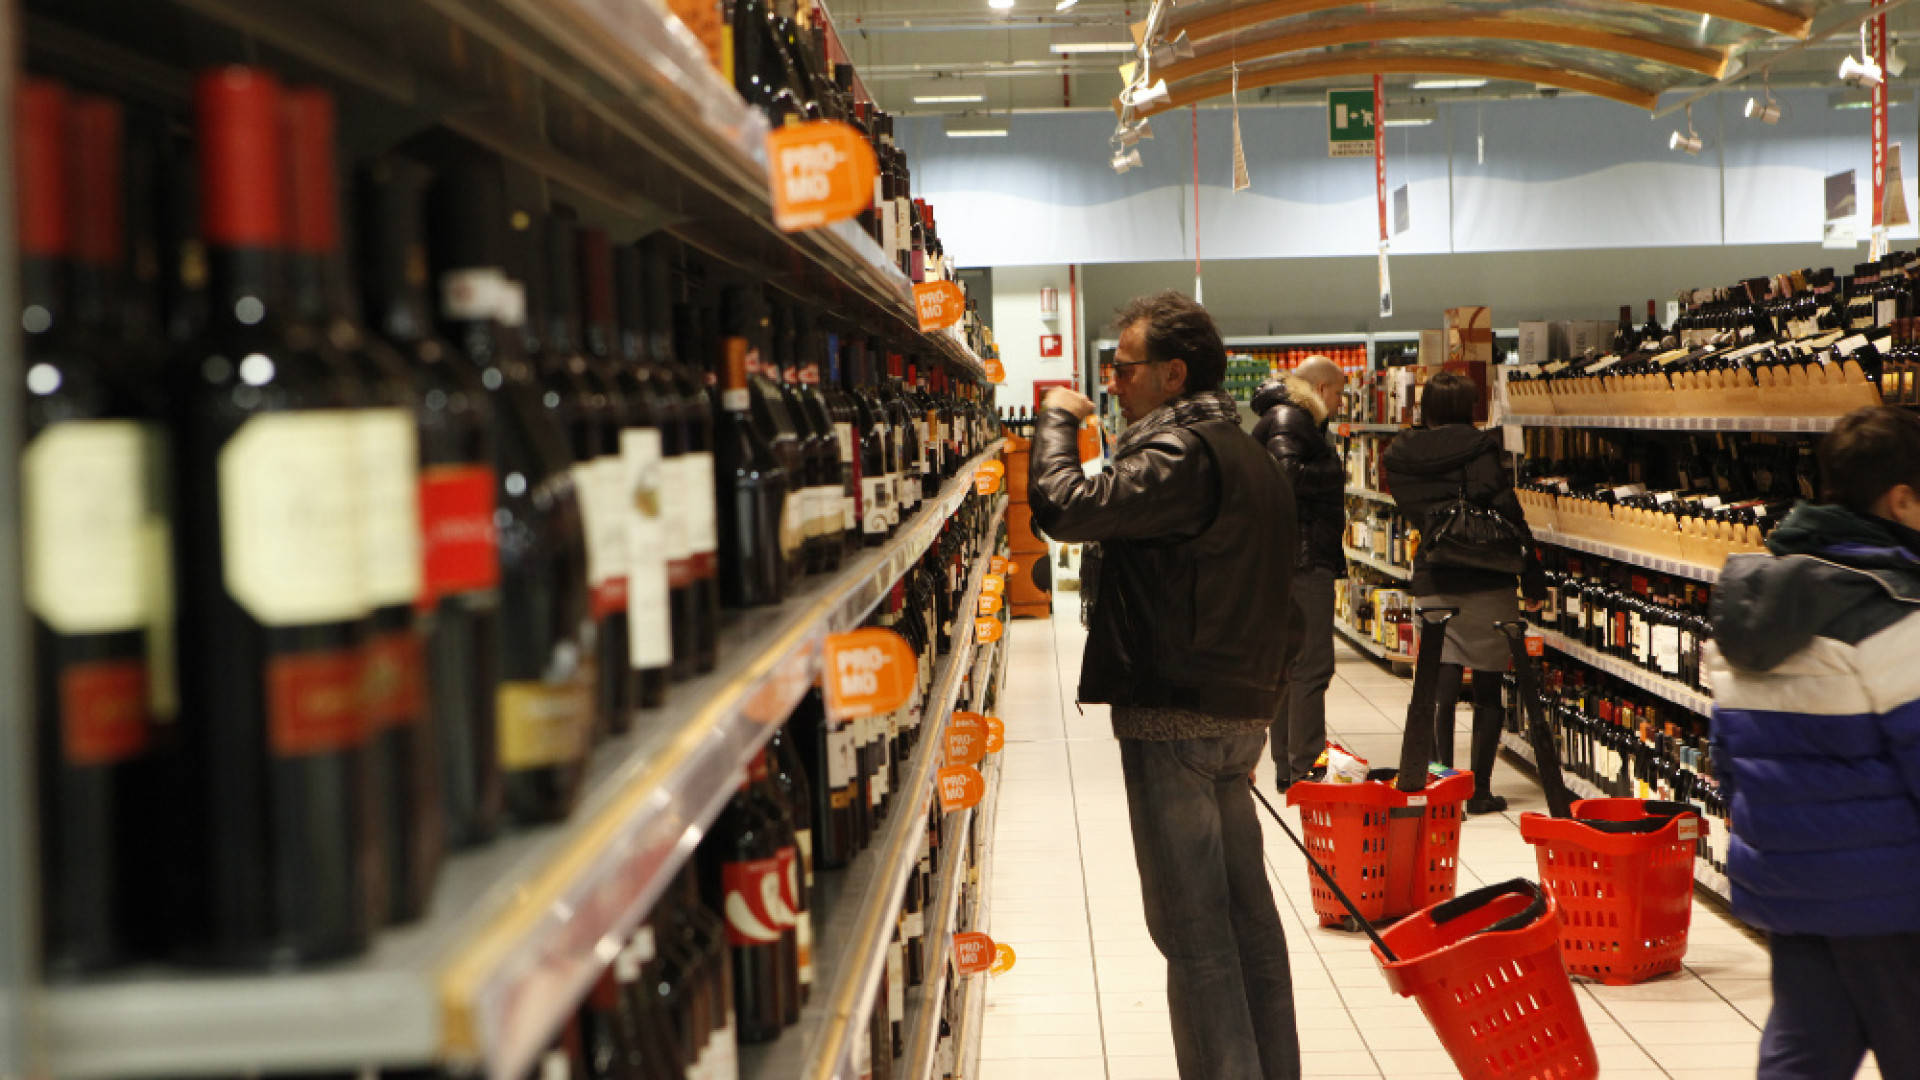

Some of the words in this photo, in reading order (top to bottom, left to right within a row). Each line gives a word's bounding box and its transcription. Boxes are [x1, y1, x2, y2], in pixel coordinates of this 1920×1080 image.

[782, 142, 848, 174] PRO-
[787, 173, 831, 203] MO
[920, 289, 949, 306] PRO-
[922, 304, 942, 319] MO
[838, 646, 894, 673] PRO-
[841, 672, 878, 697] MO
[950, 734, 975, 746] PRO-
[952, 746, 968, 757] MO
[943, 774, 971, 788] PRO-
[945, 785, 965, 801] MO
[960, 942, 984, 954] PRO-
[962, 952, 978, 965] MO
